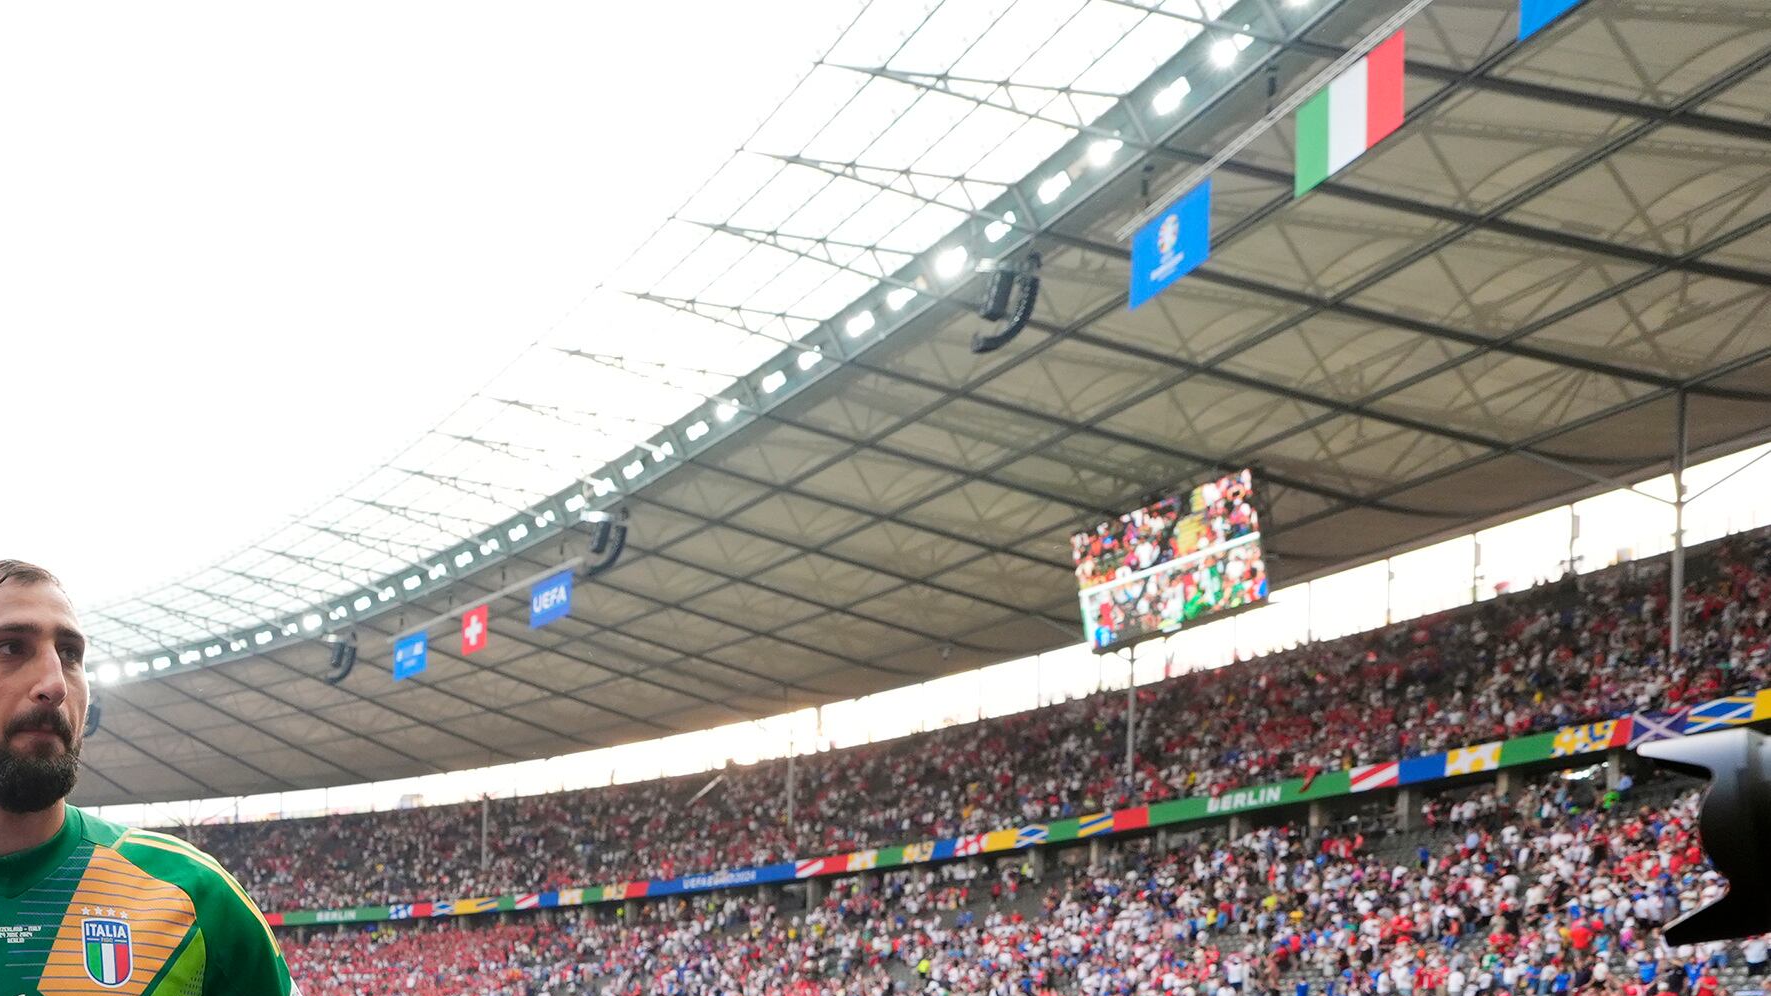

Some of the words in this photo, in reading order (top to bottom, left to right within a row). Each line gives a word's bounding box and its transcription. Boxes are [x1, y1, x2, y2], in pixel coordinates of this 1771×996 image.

[533, 585, 567, 613] UEFA
[1207, 786, 1281, 813] BERLIN
[85, 923, 127, 938] ITALIA
